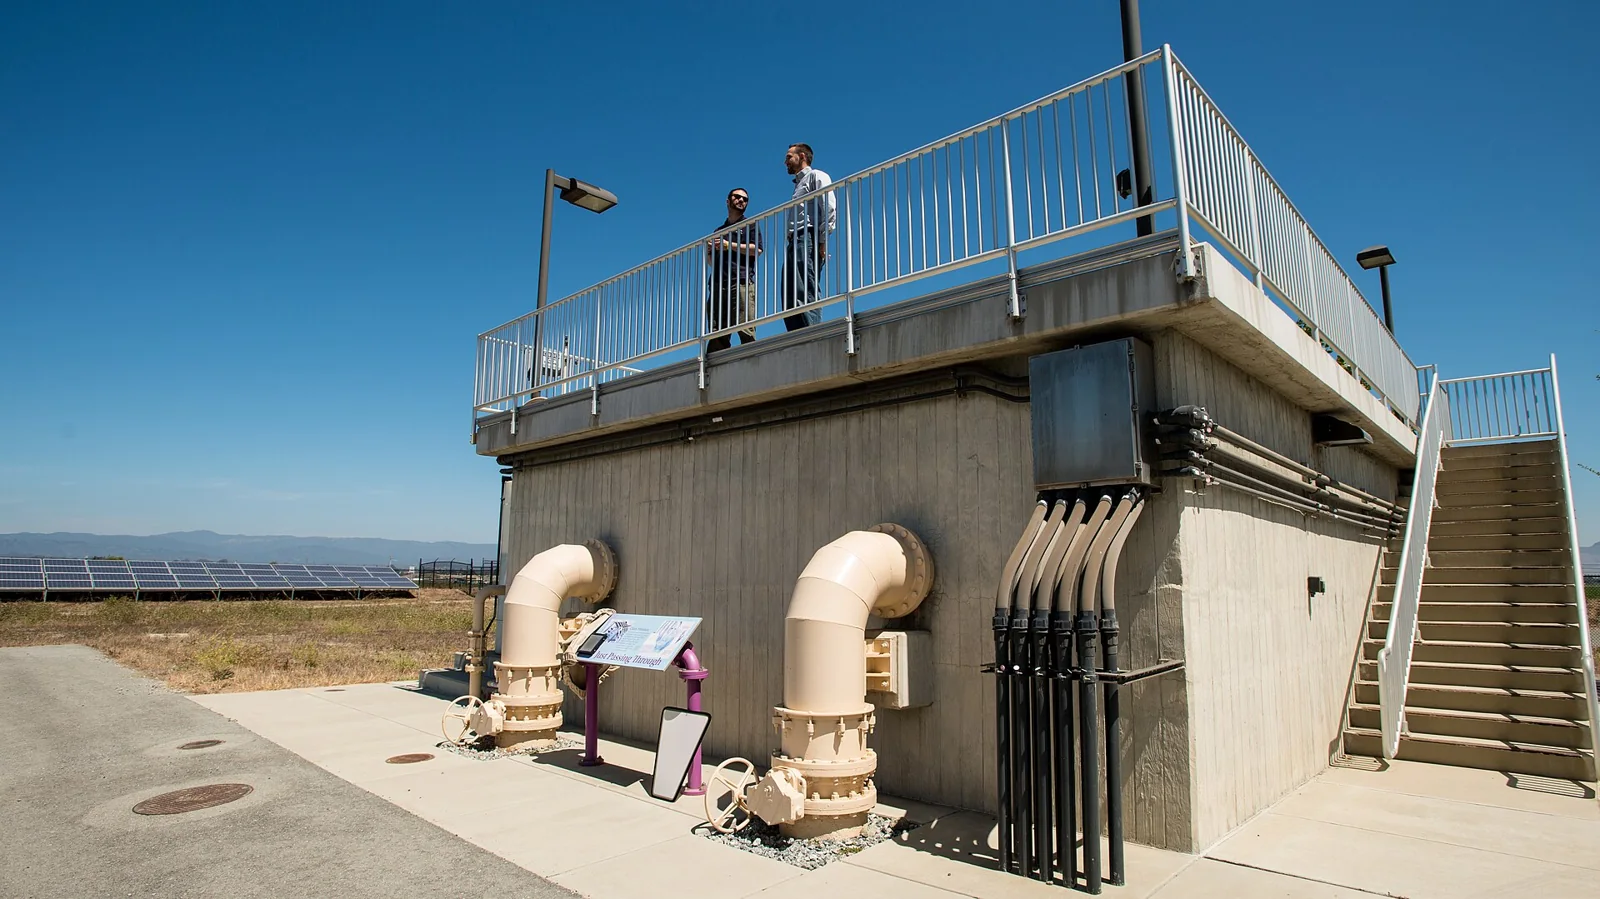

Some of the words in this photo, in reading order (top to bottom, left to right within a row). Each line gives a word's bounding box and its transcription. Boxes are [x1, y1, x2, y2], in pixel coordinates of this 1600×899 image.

[594, 651, 606, 659] Just
[606, 652, 633, 664] Passing
[632, 654, 662, 667] Through
